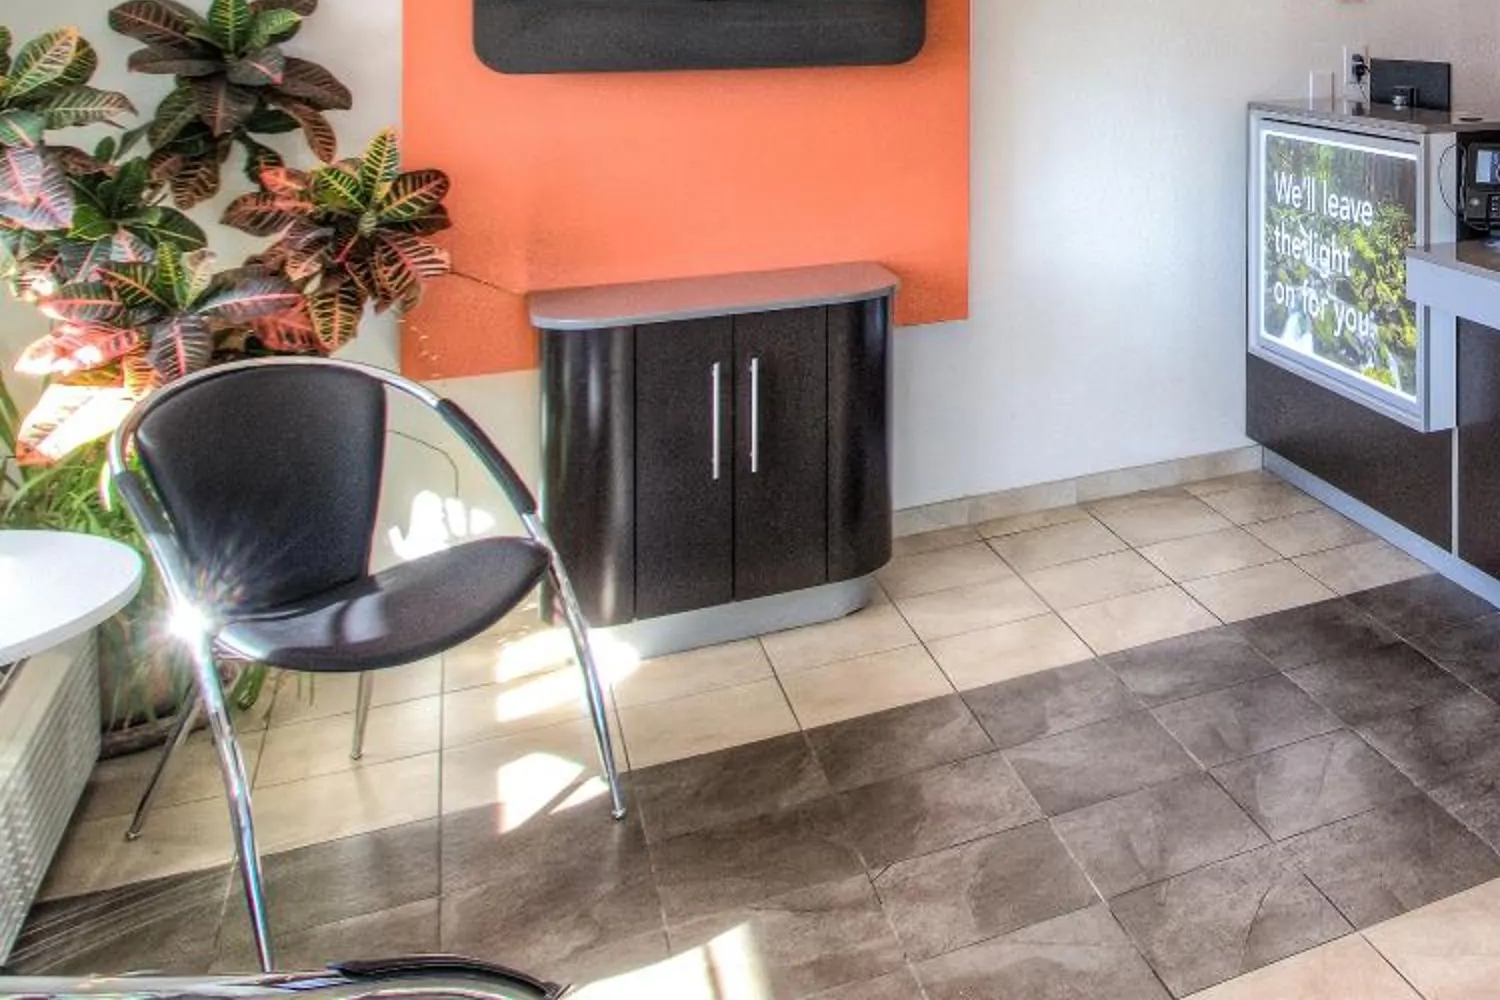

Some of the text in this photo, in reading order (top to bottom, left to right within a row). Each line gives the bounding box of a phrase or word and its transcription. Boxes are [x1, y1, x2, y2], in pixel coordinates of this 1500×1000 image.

[1274, 170, 1373, 226] We'll leave
[1274, 222, 1352, 278] the light
[1273, 281, 1295, 308] on
[1301, 280, 1329, 321] for
